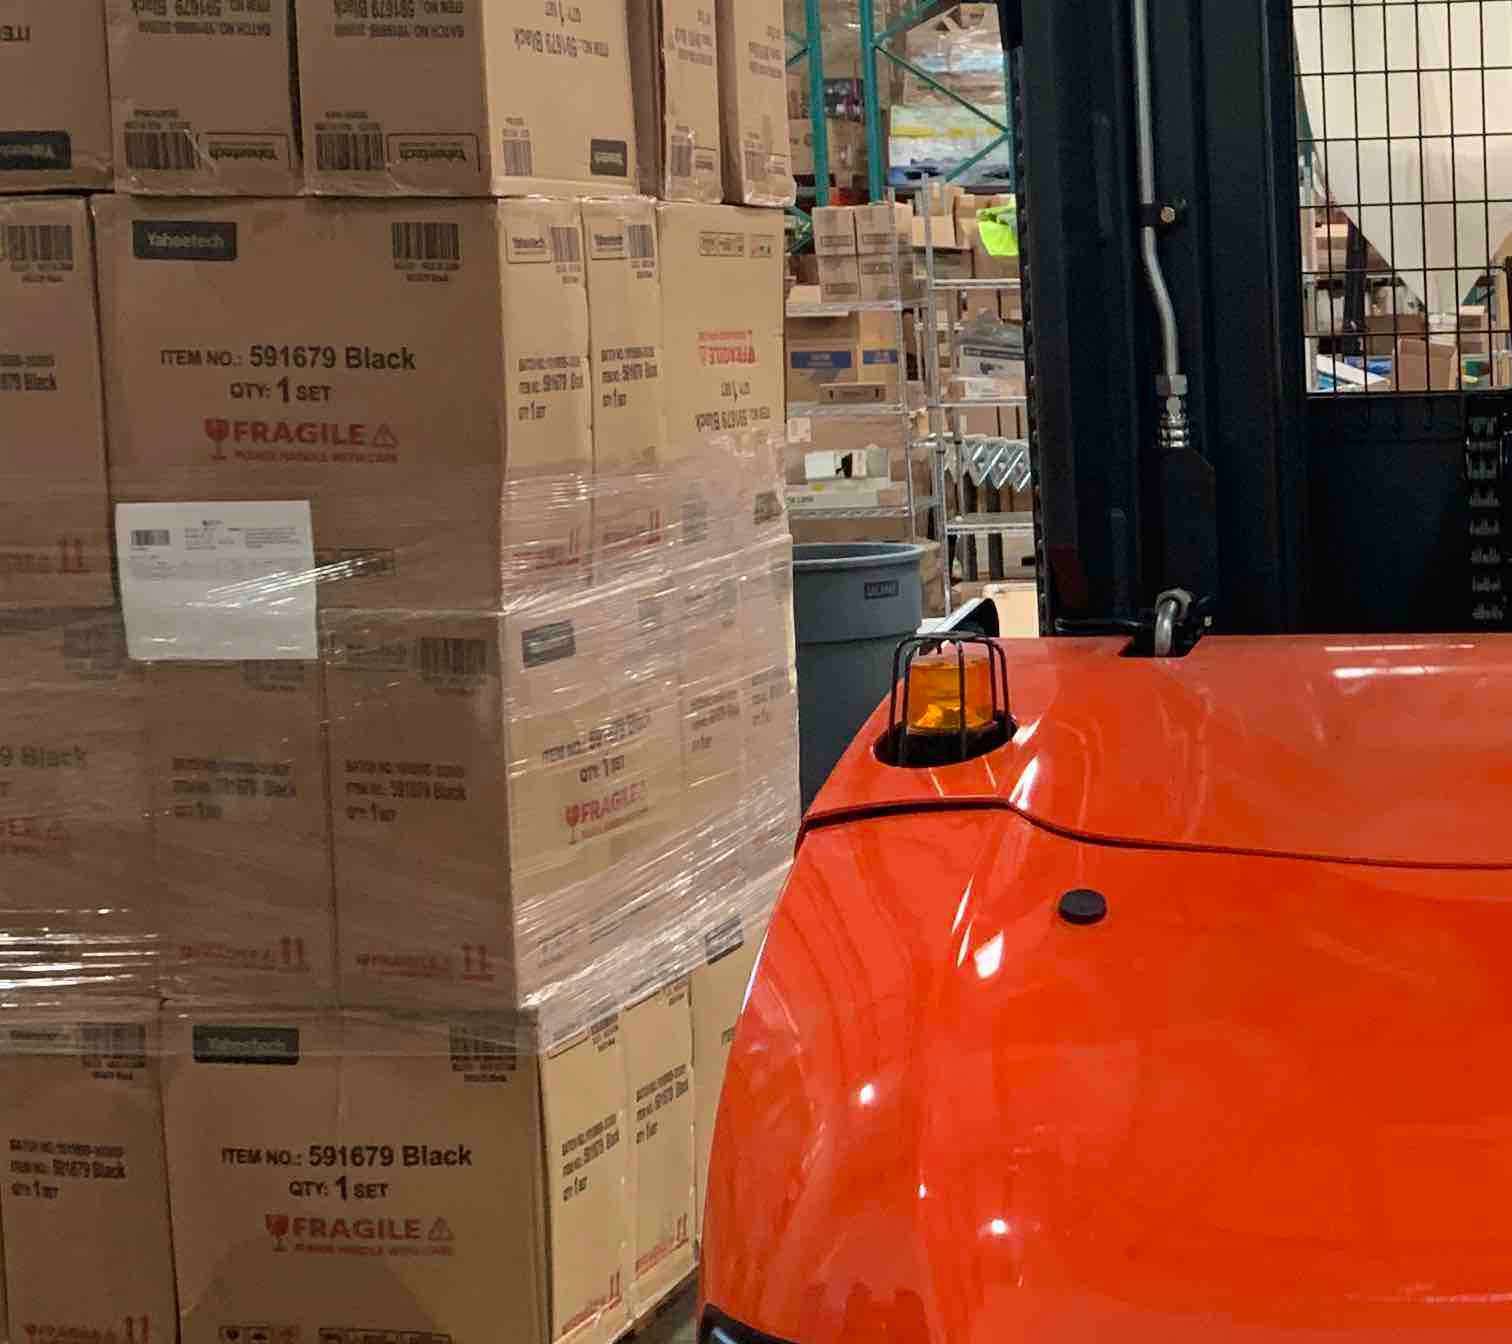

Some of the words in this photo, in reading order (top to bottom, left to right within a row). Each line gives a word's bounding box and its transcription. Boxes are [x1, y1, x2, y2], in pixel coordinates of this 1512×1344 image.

[160, 349, 202, 367] ITEM
[249, 345, 337, 370] 591679
[345, 345, 417, 371] Black
[277, 375, 290, 403] 1
[296, 384, 332, 402] SET
[233, 420, 365, 446] FRAGILE
[580, 784, 641, 824] FRAGILE
[221, 1147, 262, 1165] ITEM
[308, 1144, 395, 1168] 591679
[402, 1143, 473, 1167] Black
[288, 1180, 329, 1198] QTY:
[334, 1174, 348, 1201] 1
[352, 1182, 390, 1199] SET
[292, 1216, 421, 1240] FRAGILE
